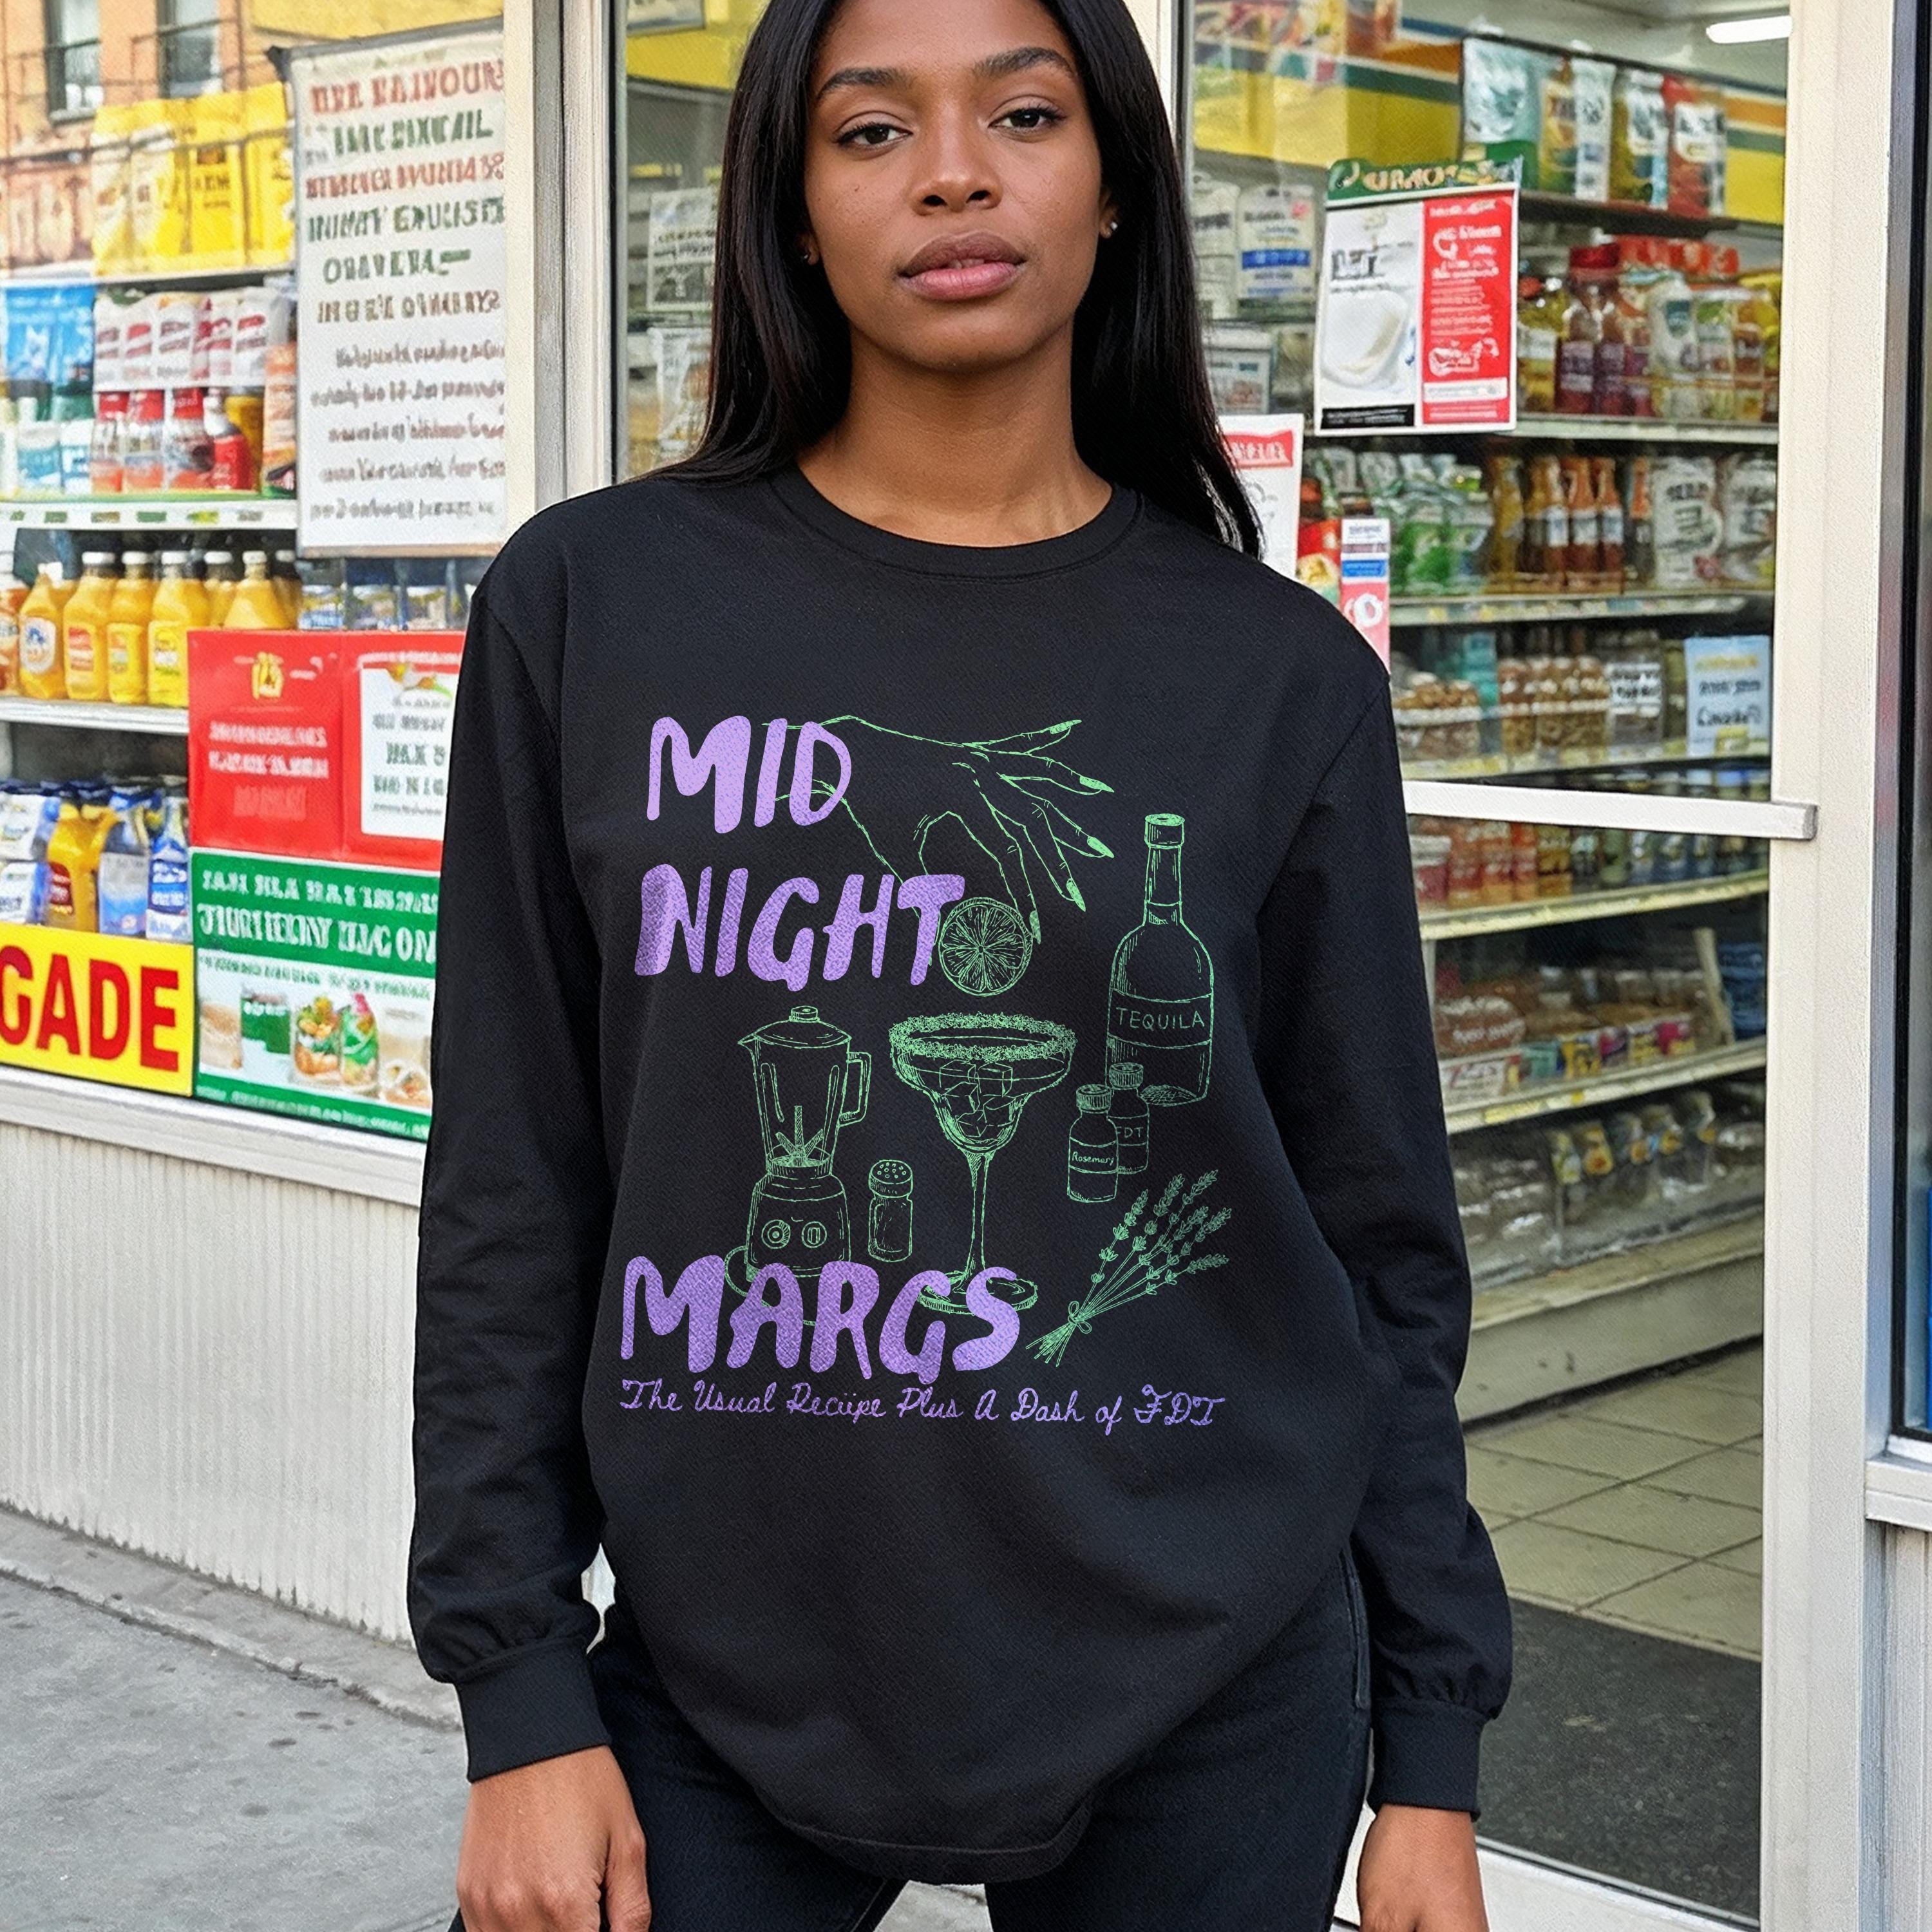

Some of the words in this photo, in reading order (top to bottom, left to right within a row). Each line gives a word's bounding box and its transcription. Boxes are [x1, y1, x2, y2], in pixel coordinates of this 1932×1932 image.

[646, 715, 852, 834] MID
[634, 863, 965, 992] NIGHT
[0, 945, 179, 1073] GADE
[1116, 1007, 1205, 1031] TEQUILA
[620, 1255, 1021, 1385] MARGS
[620, 1378, 683, 1412] The
[694, 1379, 777, 1414] Usual
[896, 1386, 964, 1418] Plus
[974, 1388, 999, 1421] A
[1010, 1387, 1085, 1422] Dash
[1095, 1395, 1122, 1436] of
